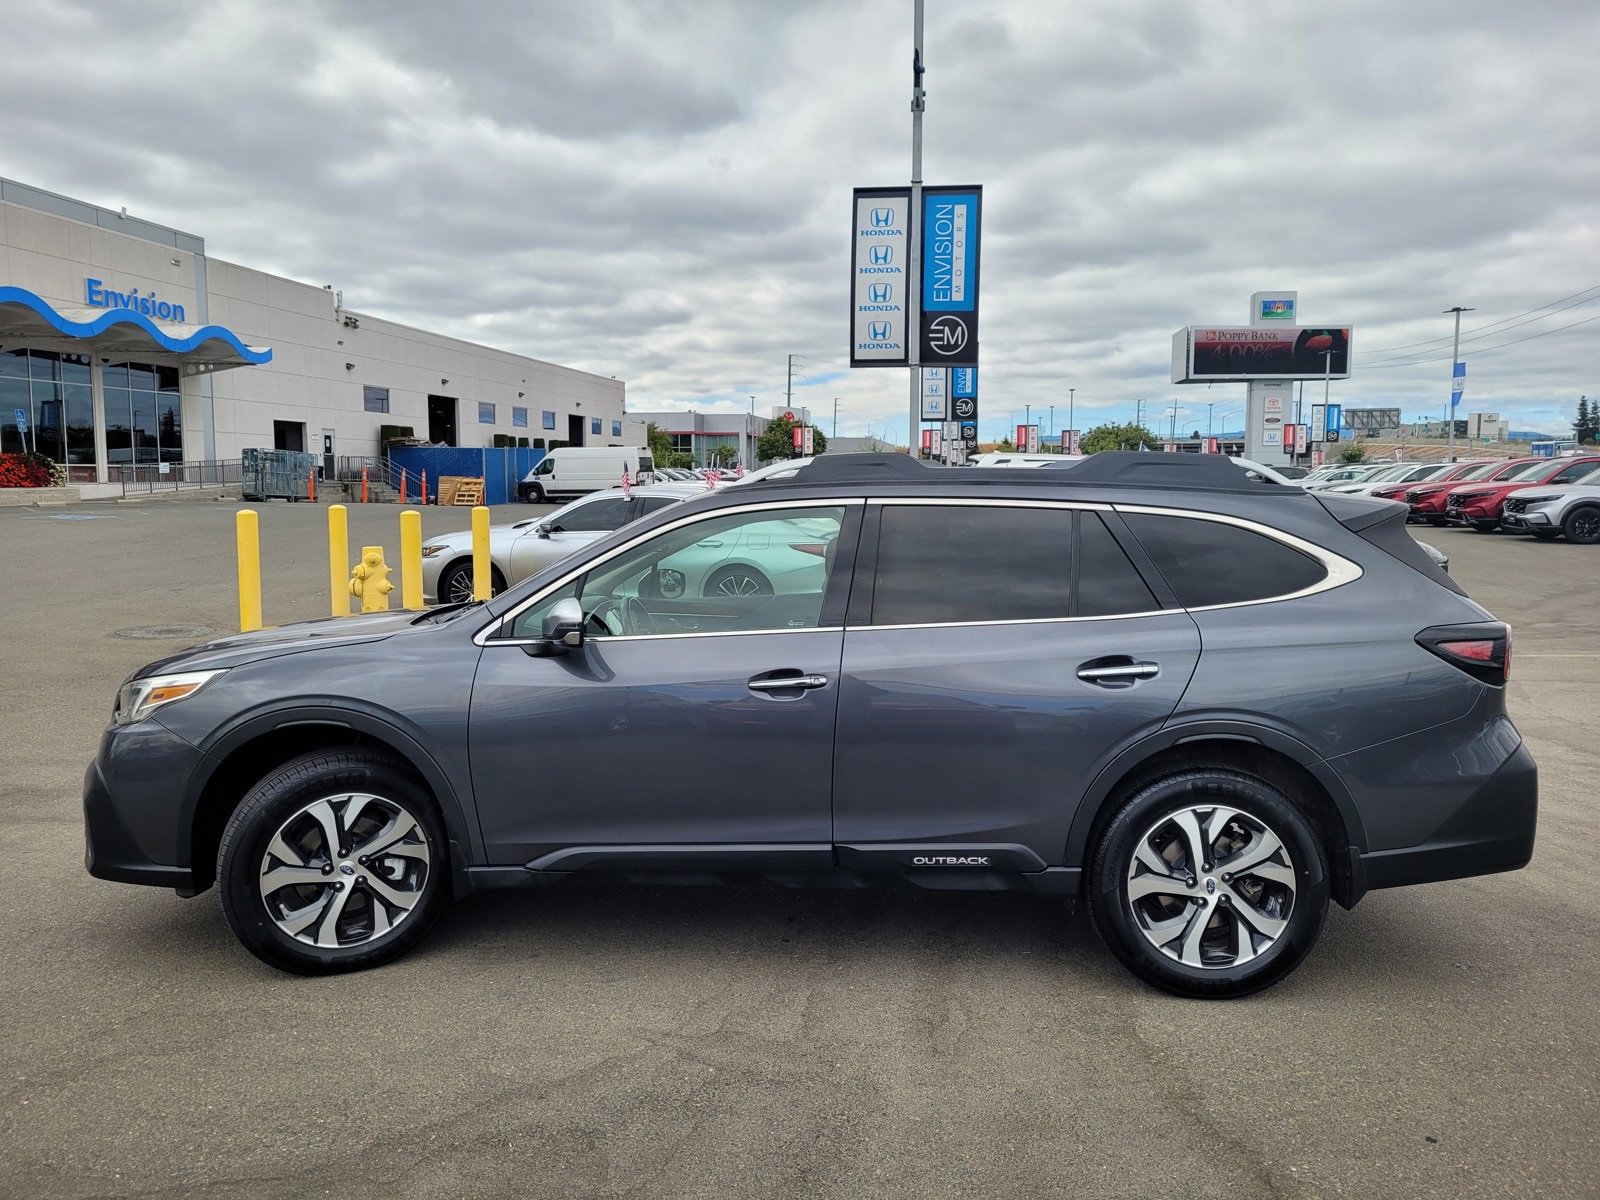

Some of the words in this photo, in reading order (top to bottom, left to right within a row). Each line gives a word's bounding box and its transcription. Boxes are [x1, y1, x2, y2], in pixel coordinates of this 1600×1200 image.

[933, 204, 953, 302] ENVISION
[955, 212, 964, 293] MOTORS
[86, 277, 185, 322] Envision
[858, 304, 901, 312] HONDA
[1218, 331, 1250, 341] POPPY
[1251, 331, 1279, 341] BANK
[858, 342, 901, 350] HONDA
[913, 856, 989, 865] OUTBACK
